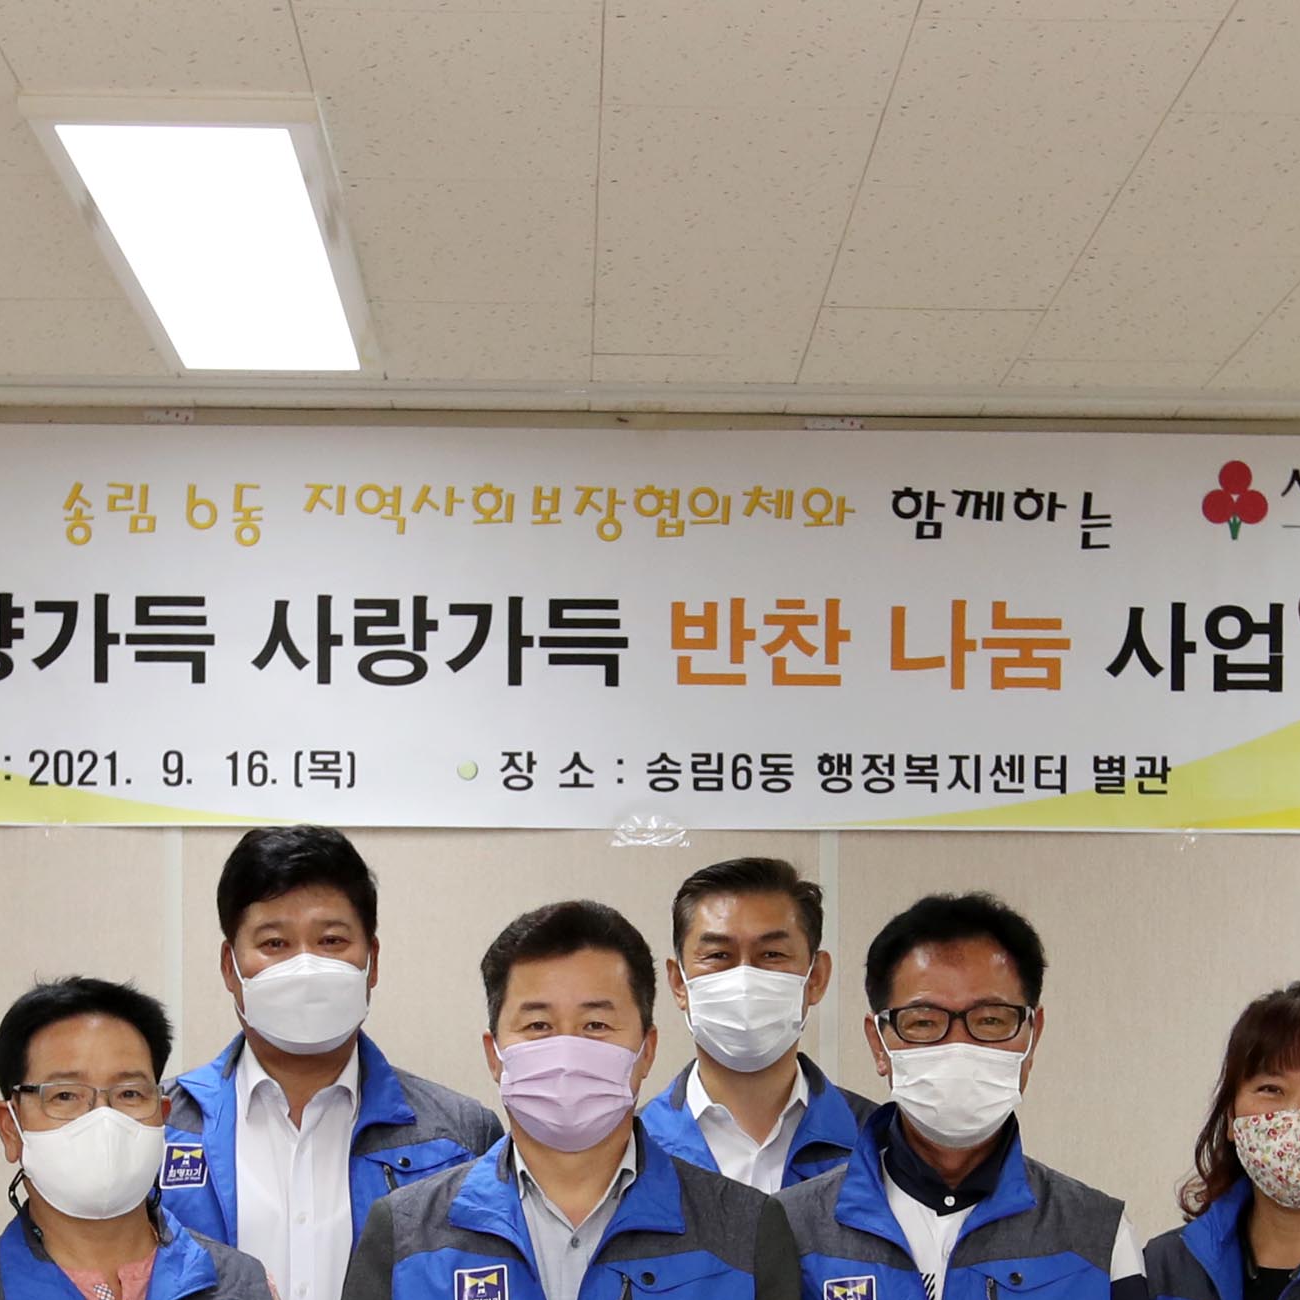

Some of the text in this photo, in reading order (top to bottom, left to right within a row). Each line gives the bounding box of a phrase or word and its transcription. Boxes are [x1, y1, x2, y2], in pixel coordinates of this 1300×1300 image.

[303, 482, 856, 543] 지역사회보장협의체와
[891, 486, 1112, 551] 함께하는
[252, 593, 628, 688] 사랑가득
[669, 598, 850, 691] 반찬
[891, 598, 1071, 692] 나눔
[1106, 601, 1285, 694] 사업
[28, 749, 132, 787] 2021.
[162, 749, 193, 787] 9.
[645, 752, 795, 793] 송림6동
[817, 753, 1068, 795] 행정복지센터
[1092, 754, 1172, 796] 별관
